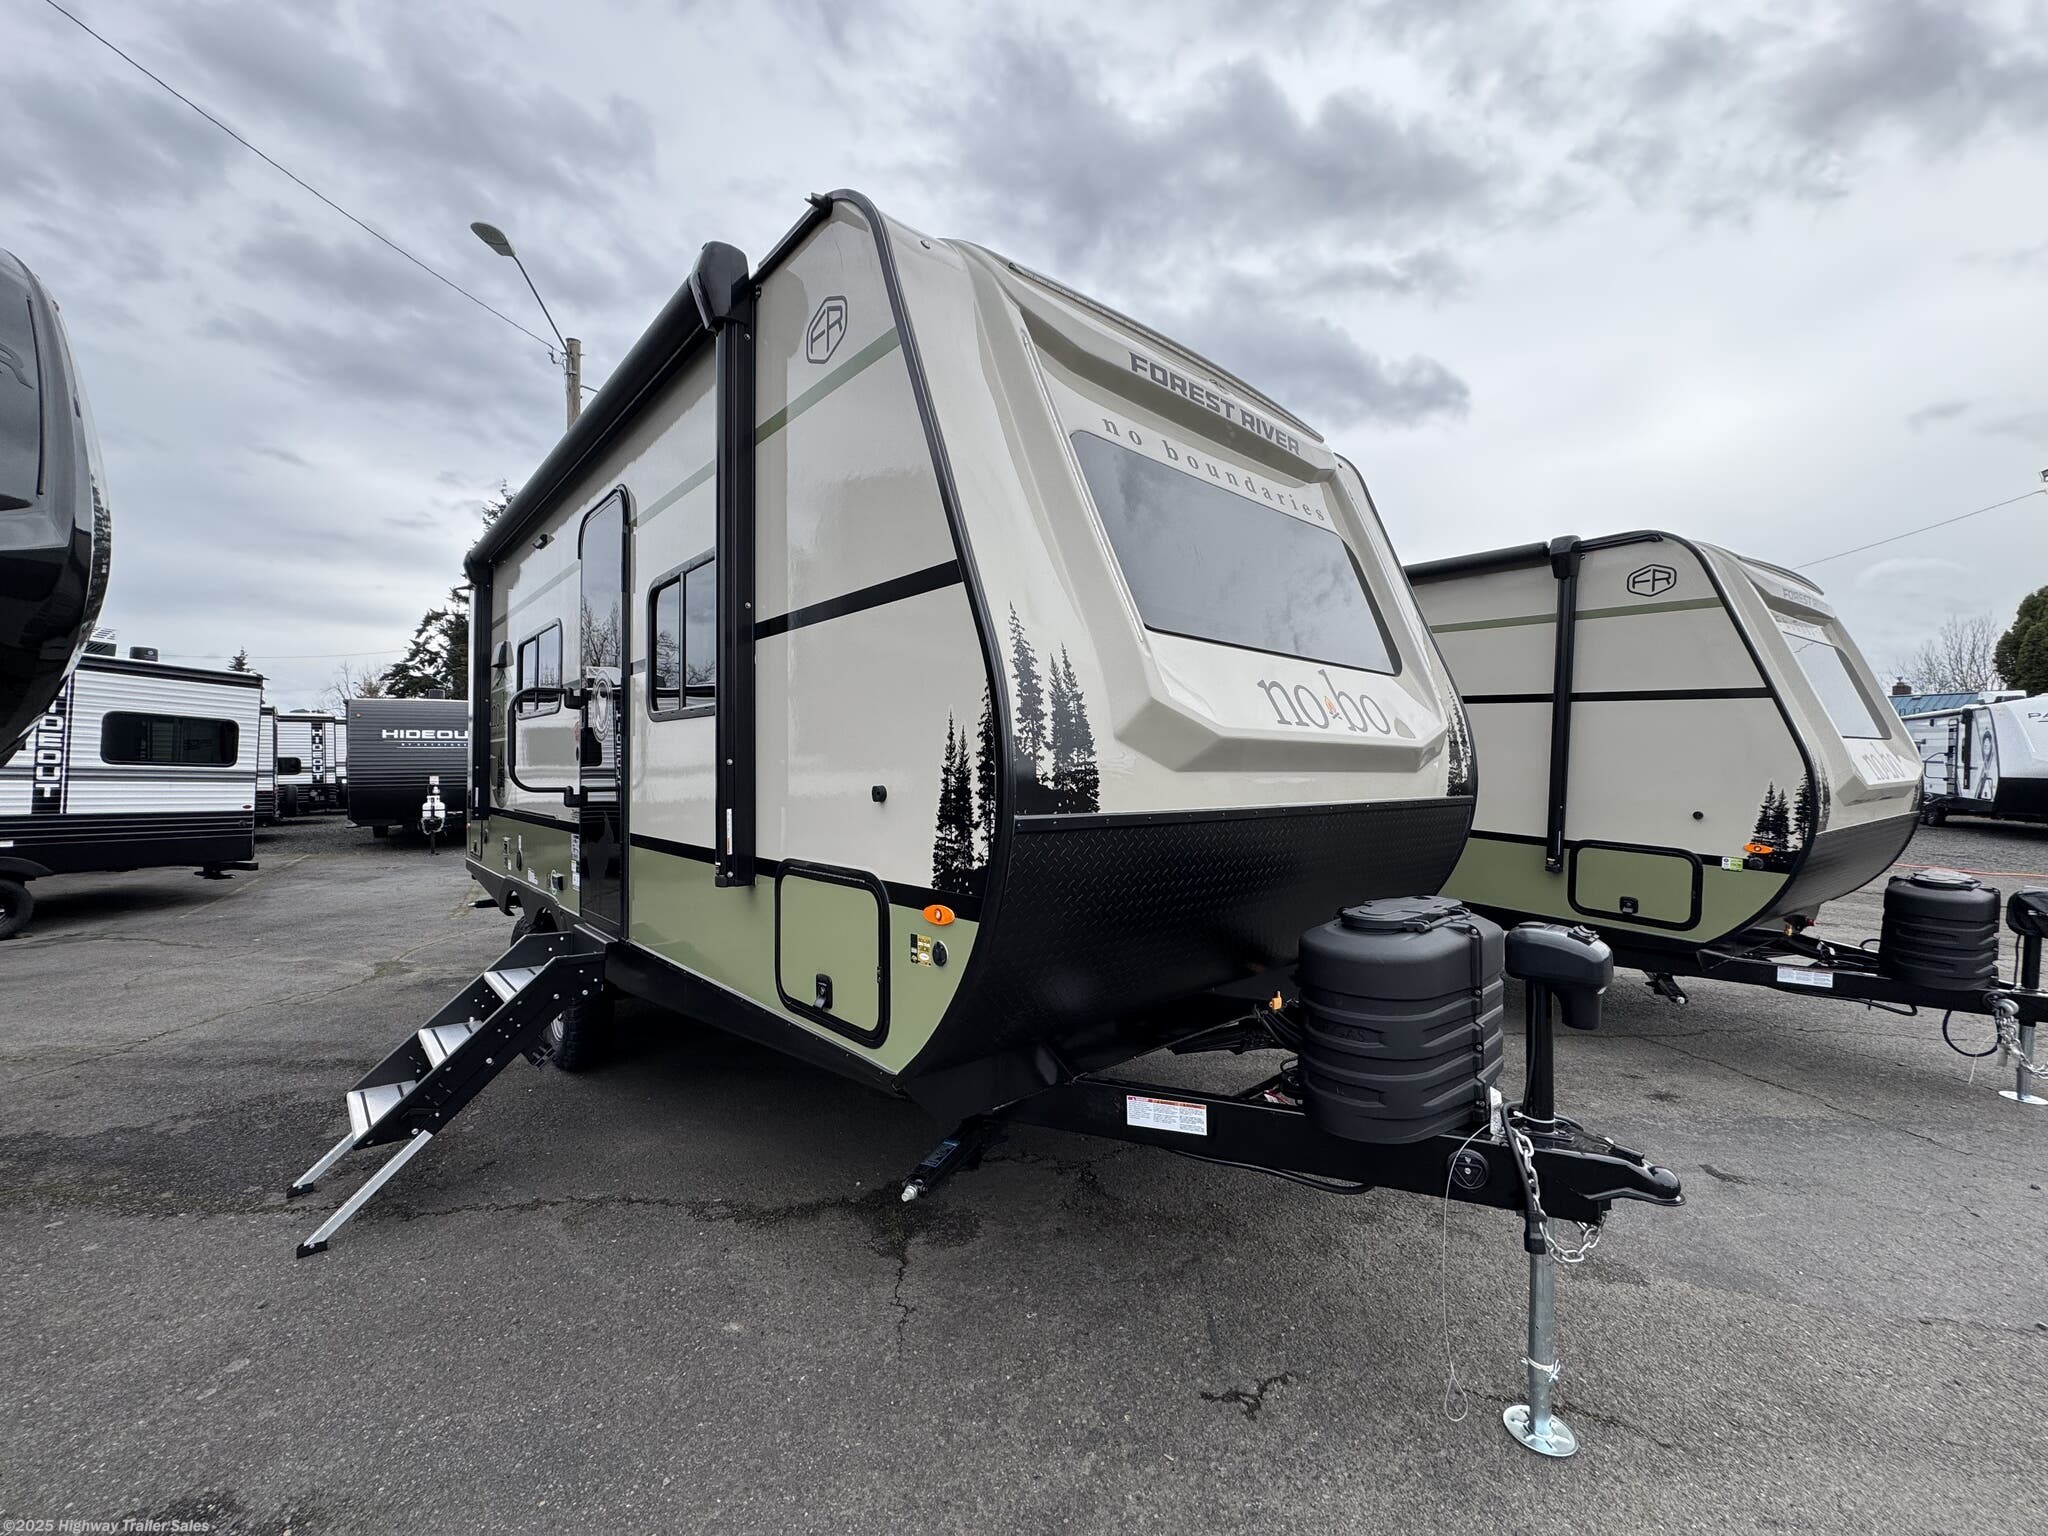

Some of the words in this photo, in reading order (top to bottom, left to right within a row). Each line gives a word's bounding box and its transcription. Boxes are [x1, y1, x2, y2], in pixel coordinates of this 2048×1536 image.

[1128, 351, 1236, 419] FOREST
[1239, 408, 1301, 455] RIVER
[1102, 416, 1142, 446] no
[1162, 439, 1325, 522] boundaries
[35, 683, 66, 798] IDEOUT
[312, 729, 323, 780] HIDEOUT
[381, 729, 468, 739] HIDEOU
